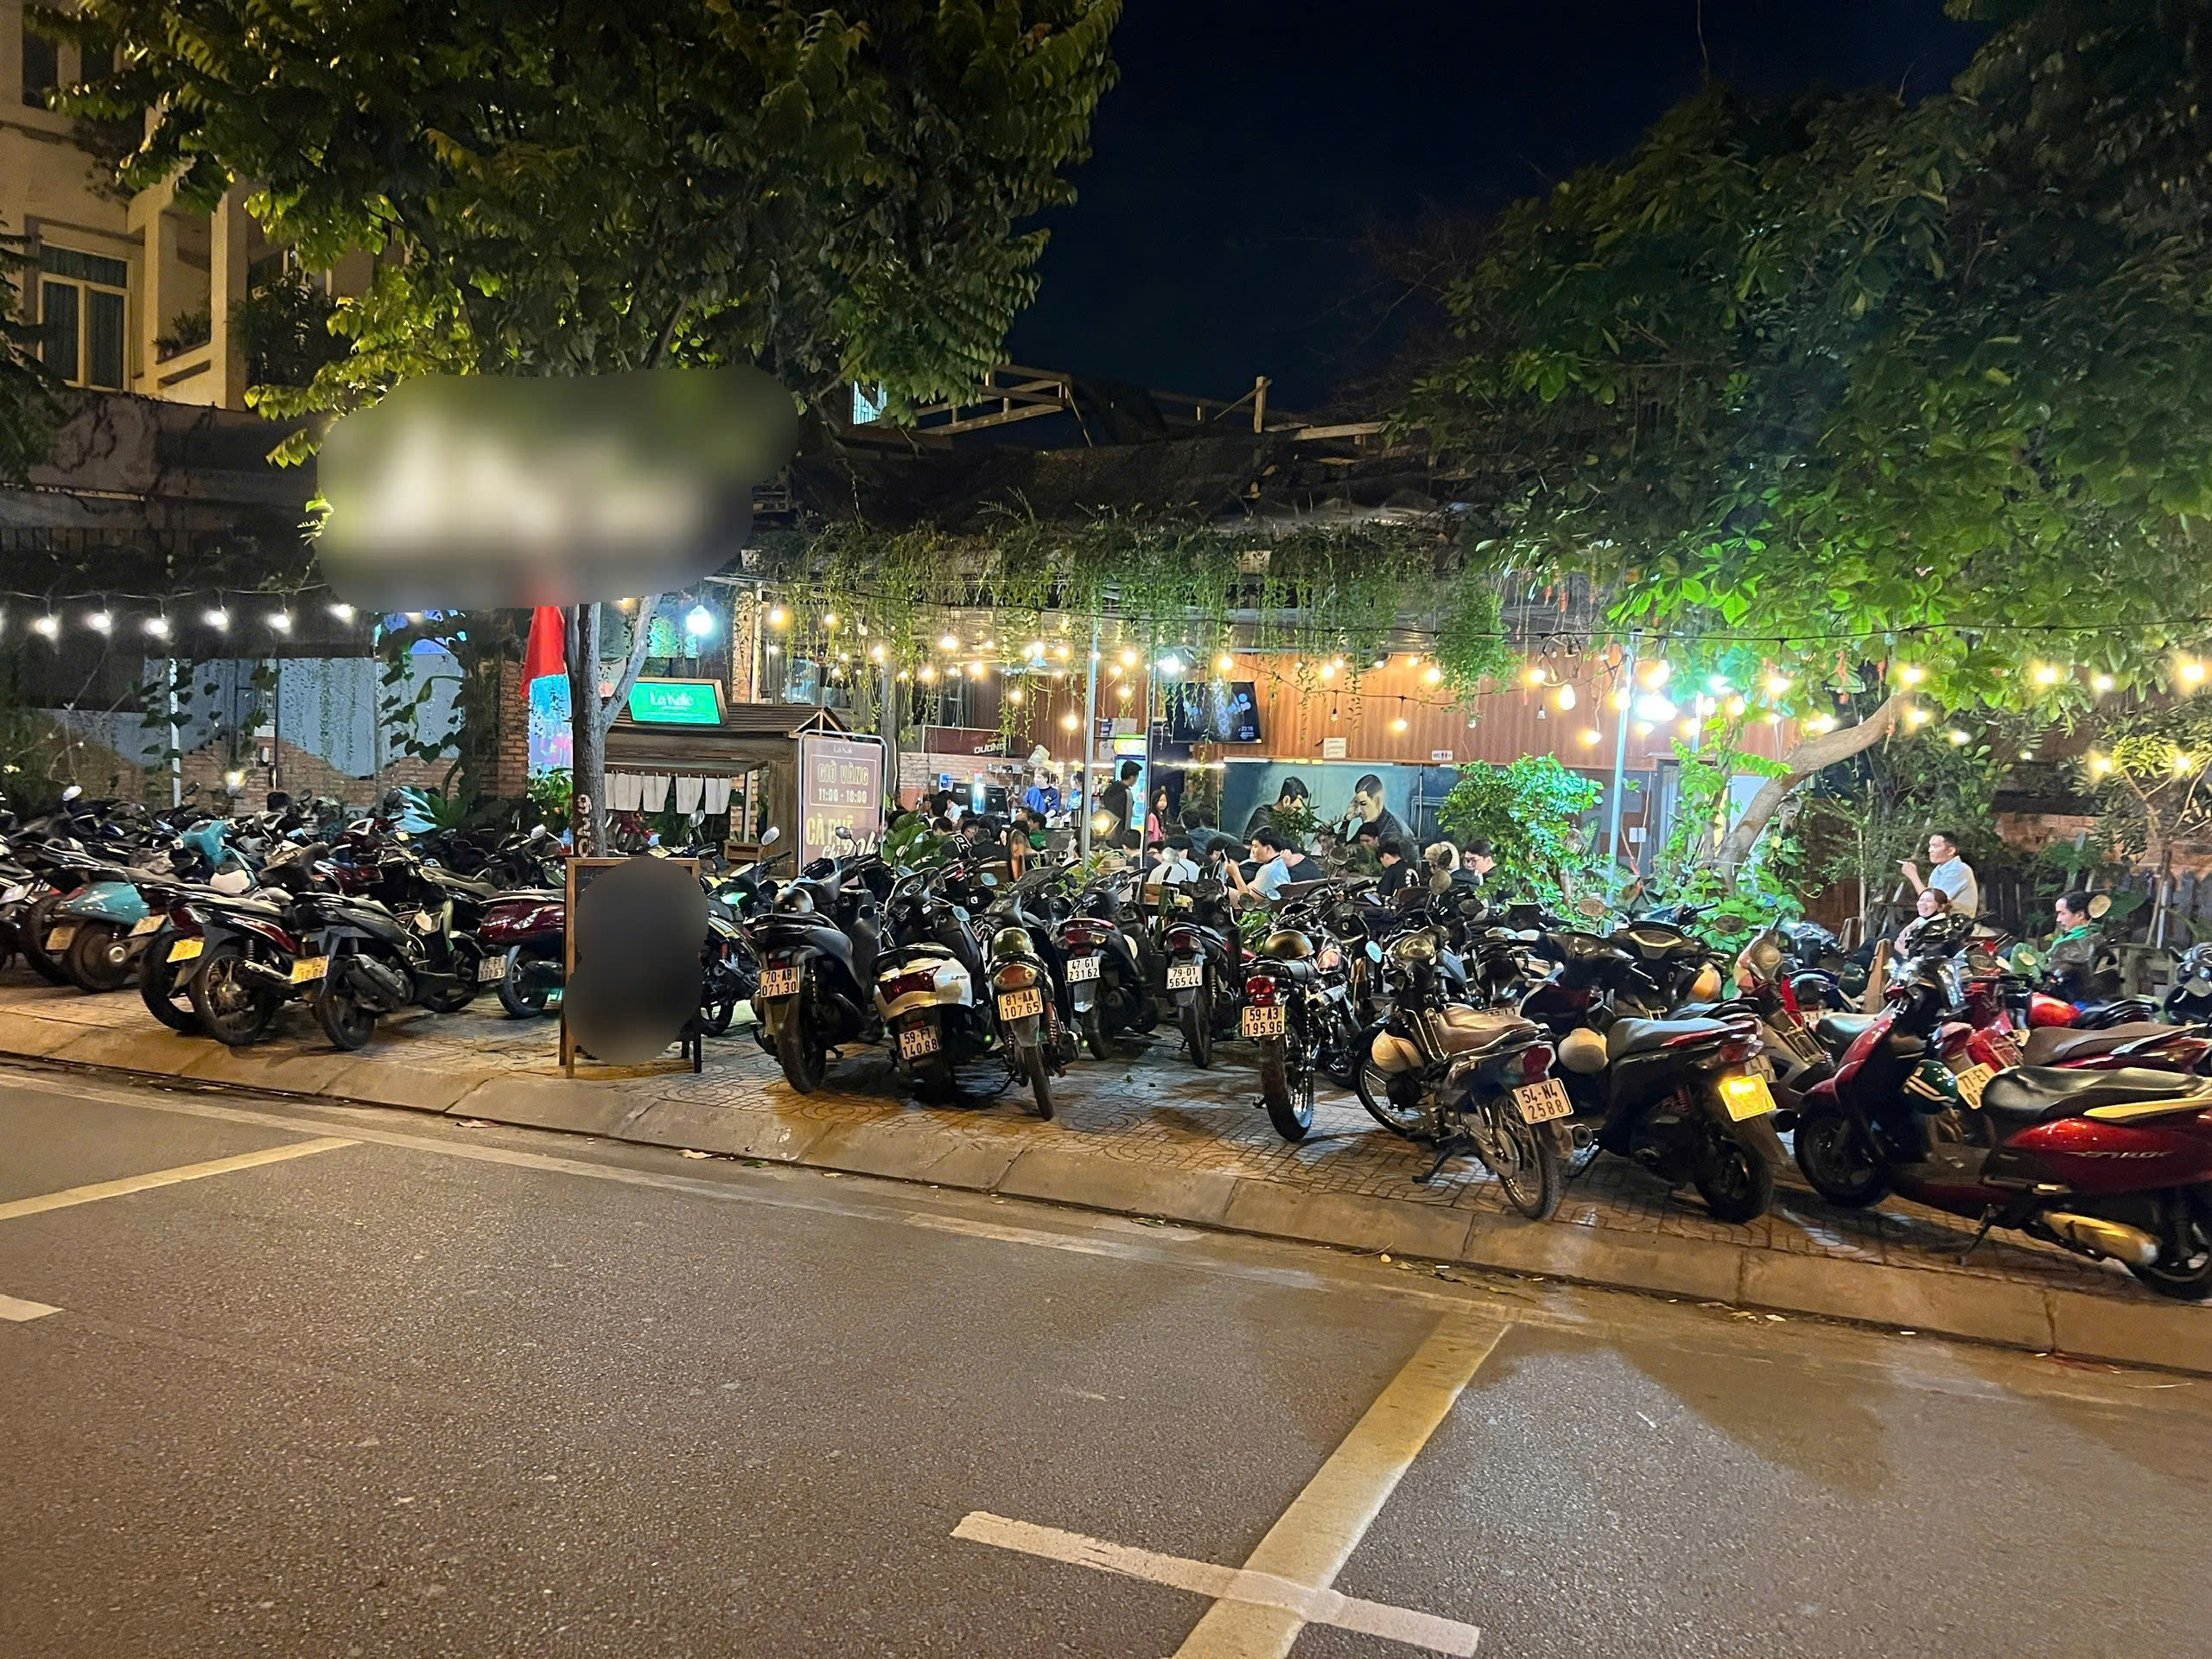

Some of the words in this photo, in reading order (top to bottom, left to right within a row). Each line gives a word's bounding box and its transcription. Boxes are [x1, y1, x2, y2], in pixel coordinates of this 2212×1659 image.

[840, 761, 869, 785] VÀNG
[818, 787, 839, 803] 11:00
[806, 813, 825, 846] CÀ
[766, 969, 792, 984] 70-AB
[762, 981, 797, 996] 071.30
[1005, 990, 1033, 1006] 81-AA
[1249, 1007, 1279, 1021] 59-A3
[904, 1027, 931, 1045] 59-F1
[1522, 1084, 1558, 1103] 54-N4
[1528, 1099, 1564, 1120] 2588
